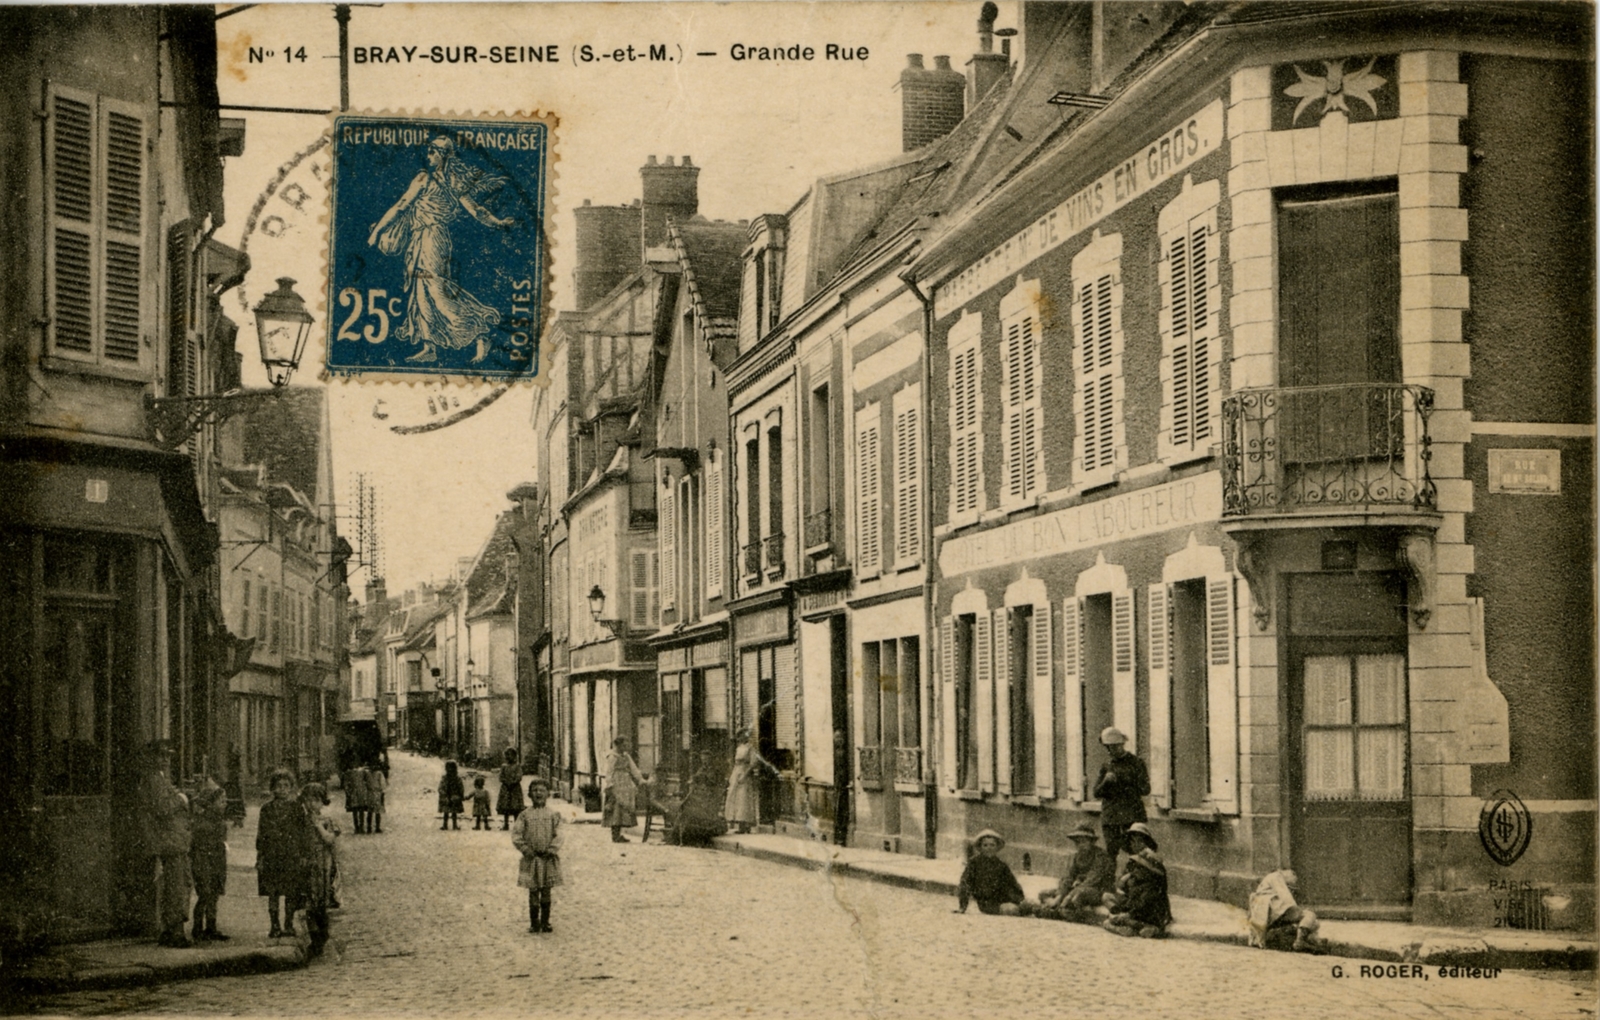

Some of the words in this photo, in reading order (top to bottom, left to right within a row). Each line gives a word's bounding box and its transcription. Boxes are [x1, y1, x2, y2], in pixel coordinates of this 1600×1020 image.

[456, 129, 538, 152] FRANÇAISE
[1039, 211, 1058, 249] DE
[1066, 181, 1104, 230] VINS
[1114, 160, 1138, 203] EN
[1147, 119, 1209, 182] GROS.
[508, 278, 532, 362] POSTES
[1514, 460, 1536, 471] RUE
[1032, 513, 1069, 553] BON
[1078, 480, 1198, 544] LABOUREUR
